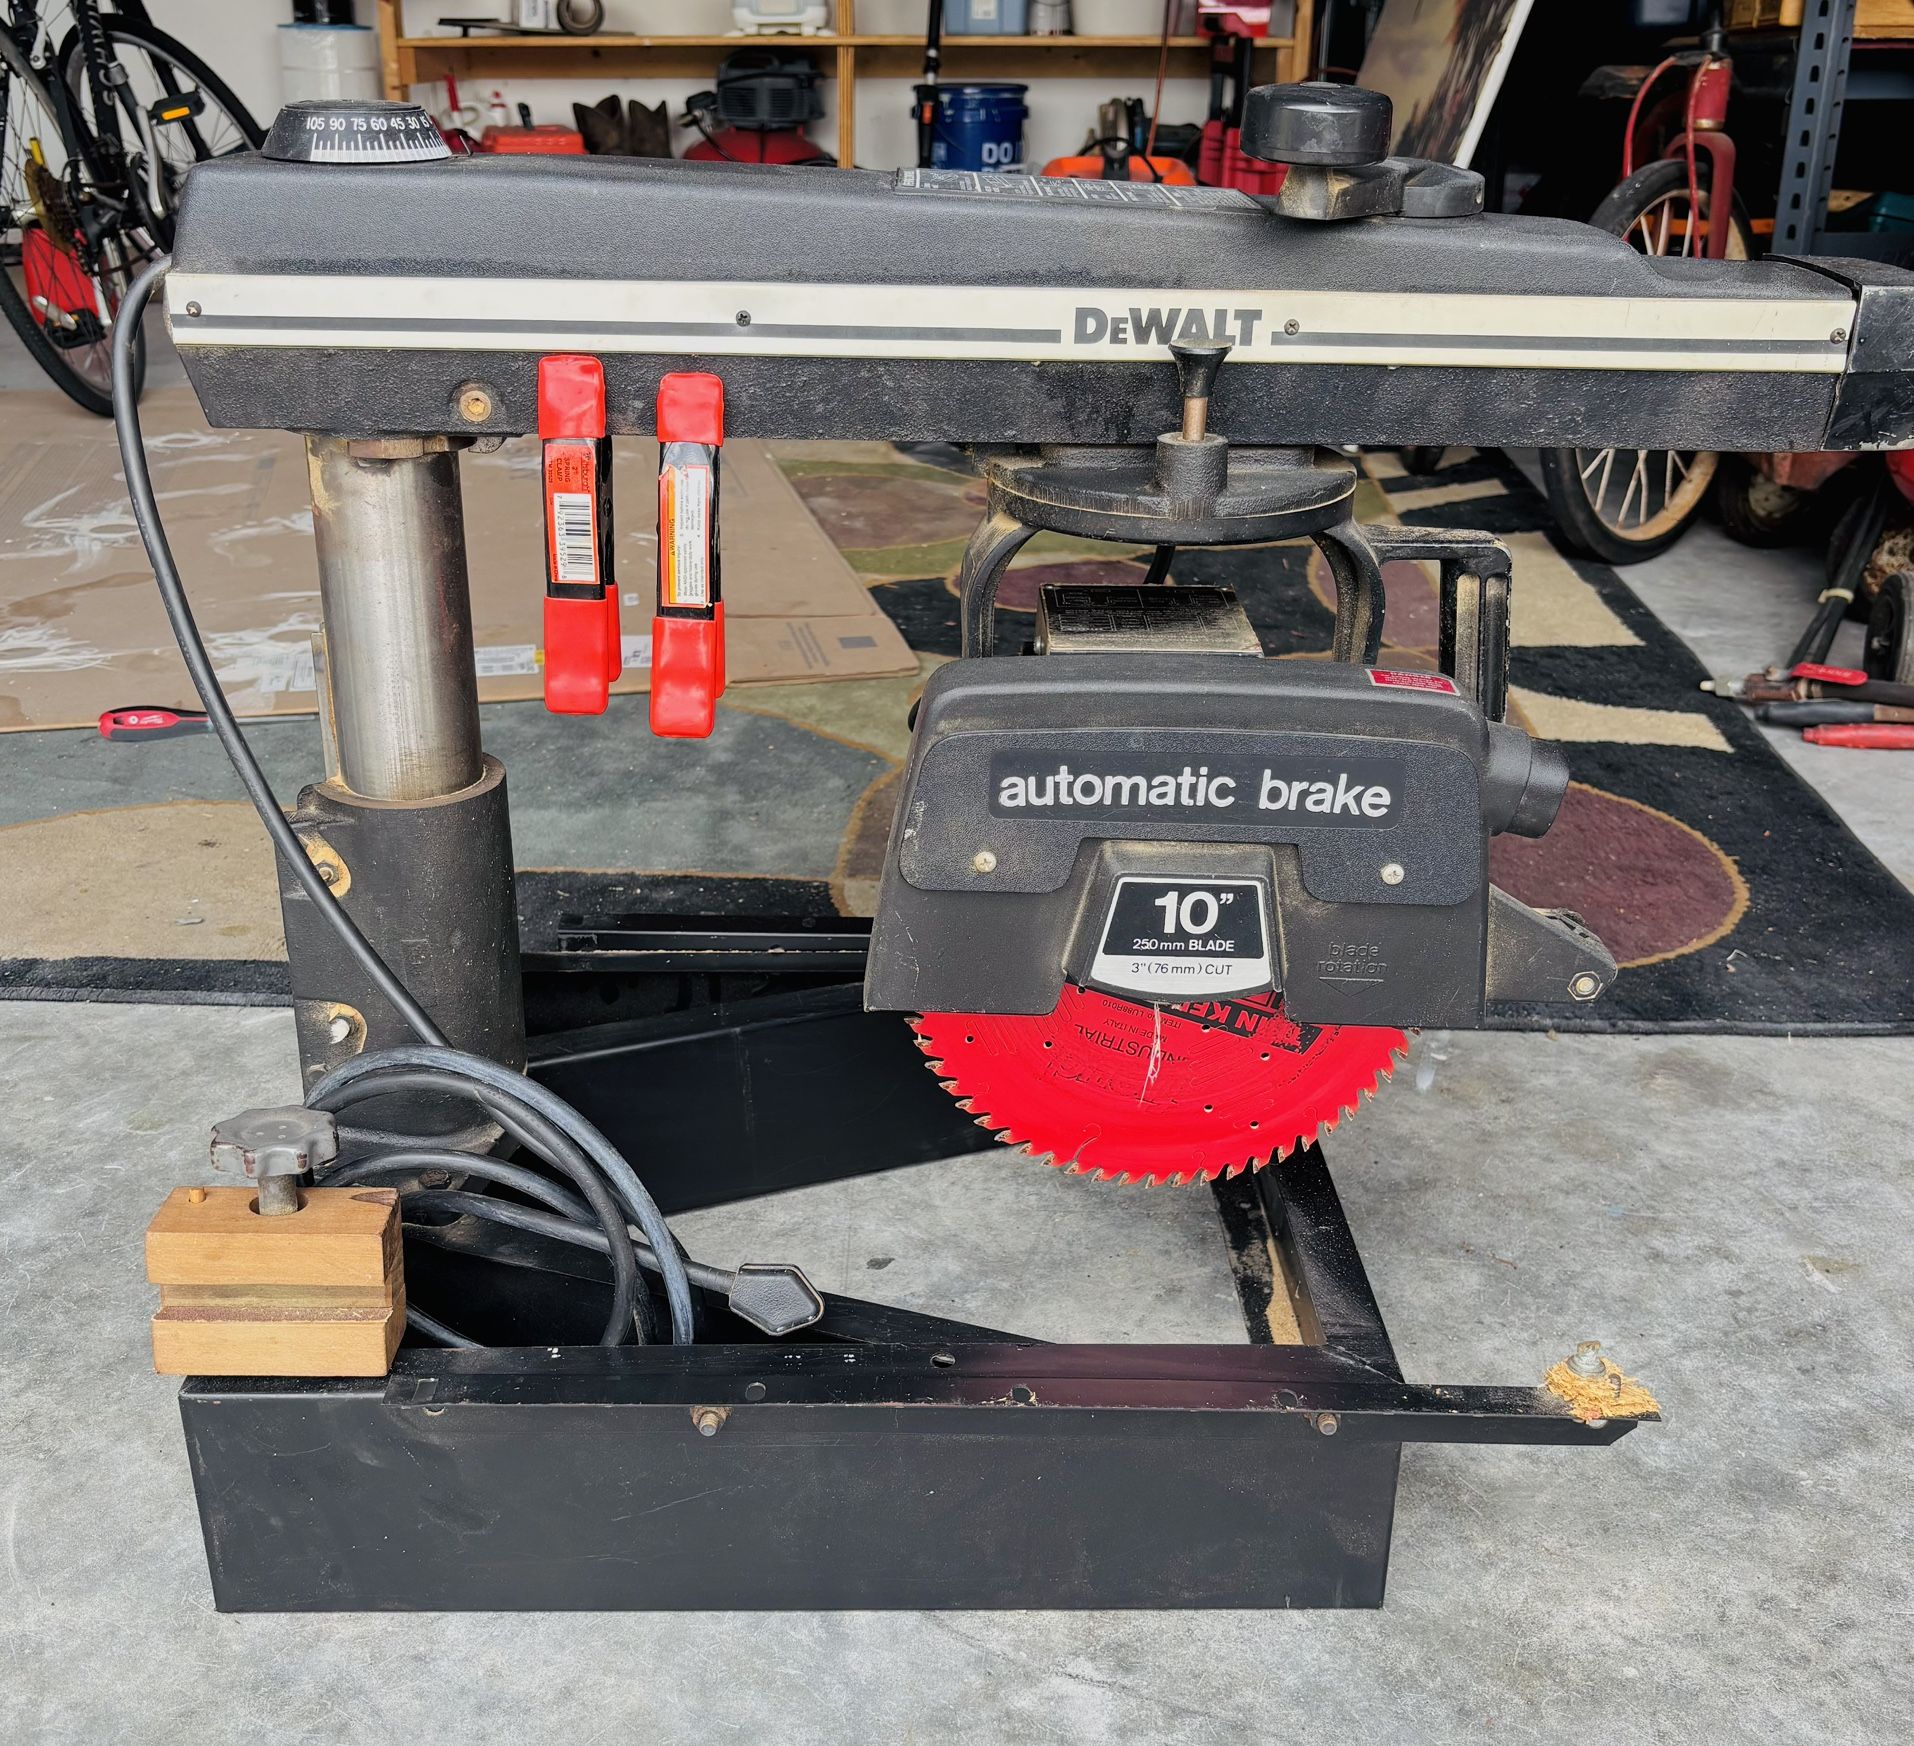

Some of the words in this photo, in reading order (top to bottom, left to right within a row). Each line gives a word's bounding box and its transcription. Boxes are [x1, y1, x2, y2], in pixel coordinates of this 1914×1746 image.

[306, 116, 325, 130] 105
[329, 117, 346, 130] 90
[351, 117, 367, 131] 75
[370, 117, 387, 131] 60
[390, 116, 406, 130] 45
[407, 116, 420, 130] 30
[420, 116, 430, 128] 15
[981, 142, 1013, 163] DO
[1074, 307, 1263, 346] DEWALT
[999, 765, 1237, 808] automatic
[1258, 769, 1392, 818] brake
[1132, 938, 1158, 950] 250
[1160, 942, 1185, 950] mm
[1188, 939, 1235, 952] BLADE
[1328, 942, 1380, 957] blade
[1205, 964, 1233, 976] CUT
[1317, 959, 1388, 974] rotation
[1103, 1018, 1127, 1031] ITALY
[1128, 1025, 1139, 1034] IN
[1160, 1016, 1182, 1029] ITEM
[1235, 1011, 1301, 1048] TIN
[1074, 1024, 1188, 1063] NDUSTRIAL
